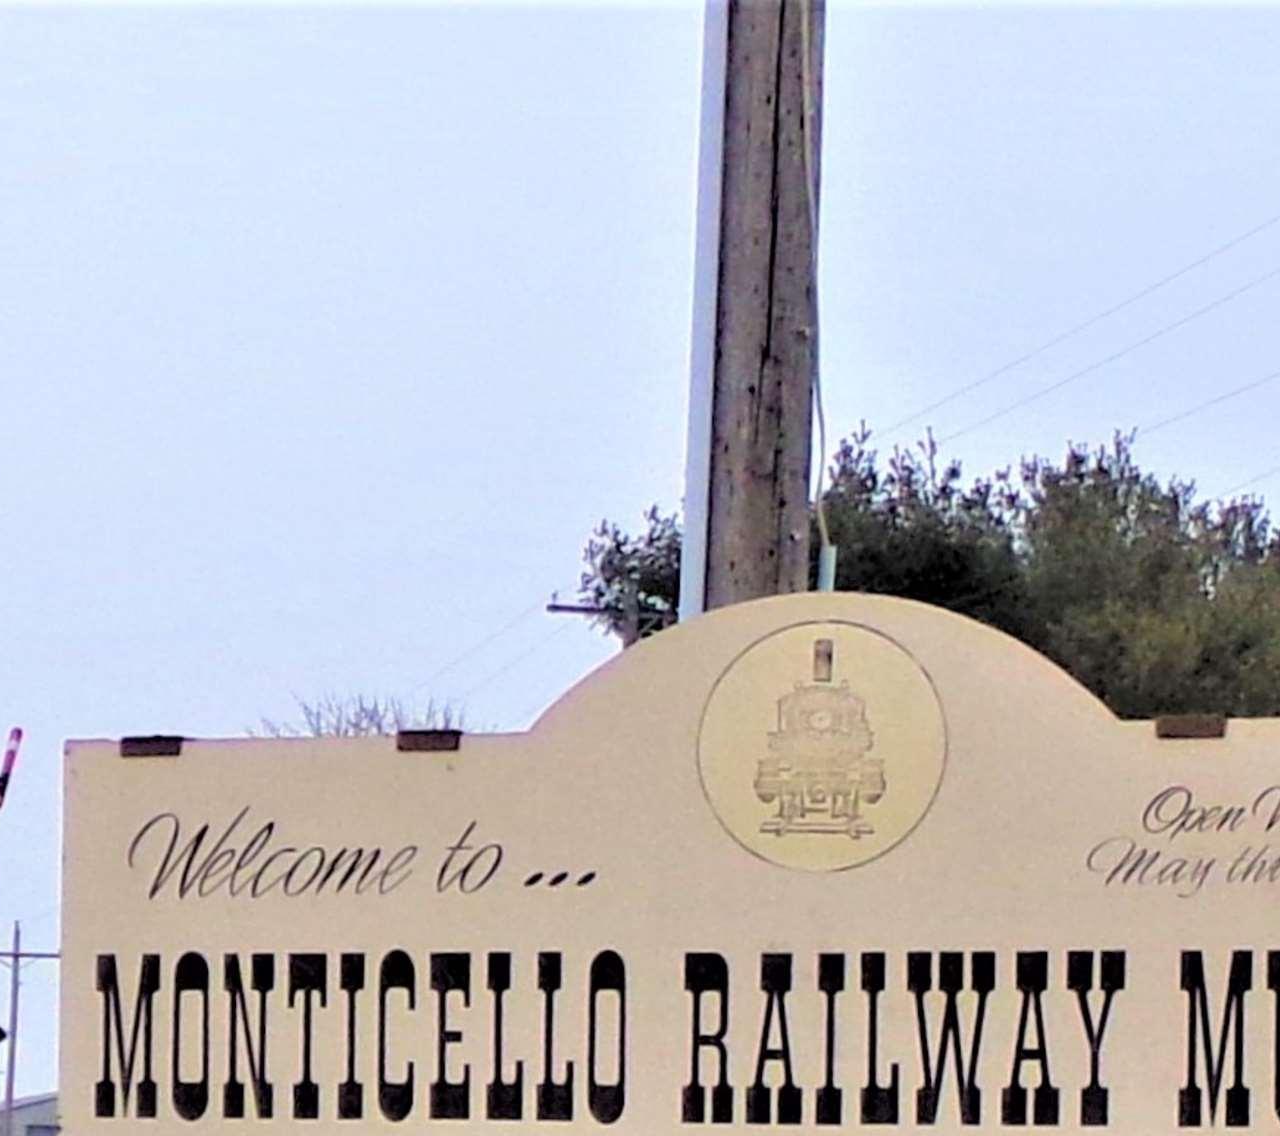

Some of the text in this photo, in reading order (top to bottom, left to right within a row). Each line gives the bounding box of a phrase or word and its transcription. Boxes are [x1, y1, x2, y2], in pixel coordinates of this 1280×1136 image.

[1141, 785, 1247, 840] Open
[127, 806, 418, 900] Welcome
[436, 820, 504, 893] to
[1085, 836, 1216, 898] May
[94, 948, 628, 1125] MONTICELLO
[680, 949, 1127, 1127] RAILWAY
